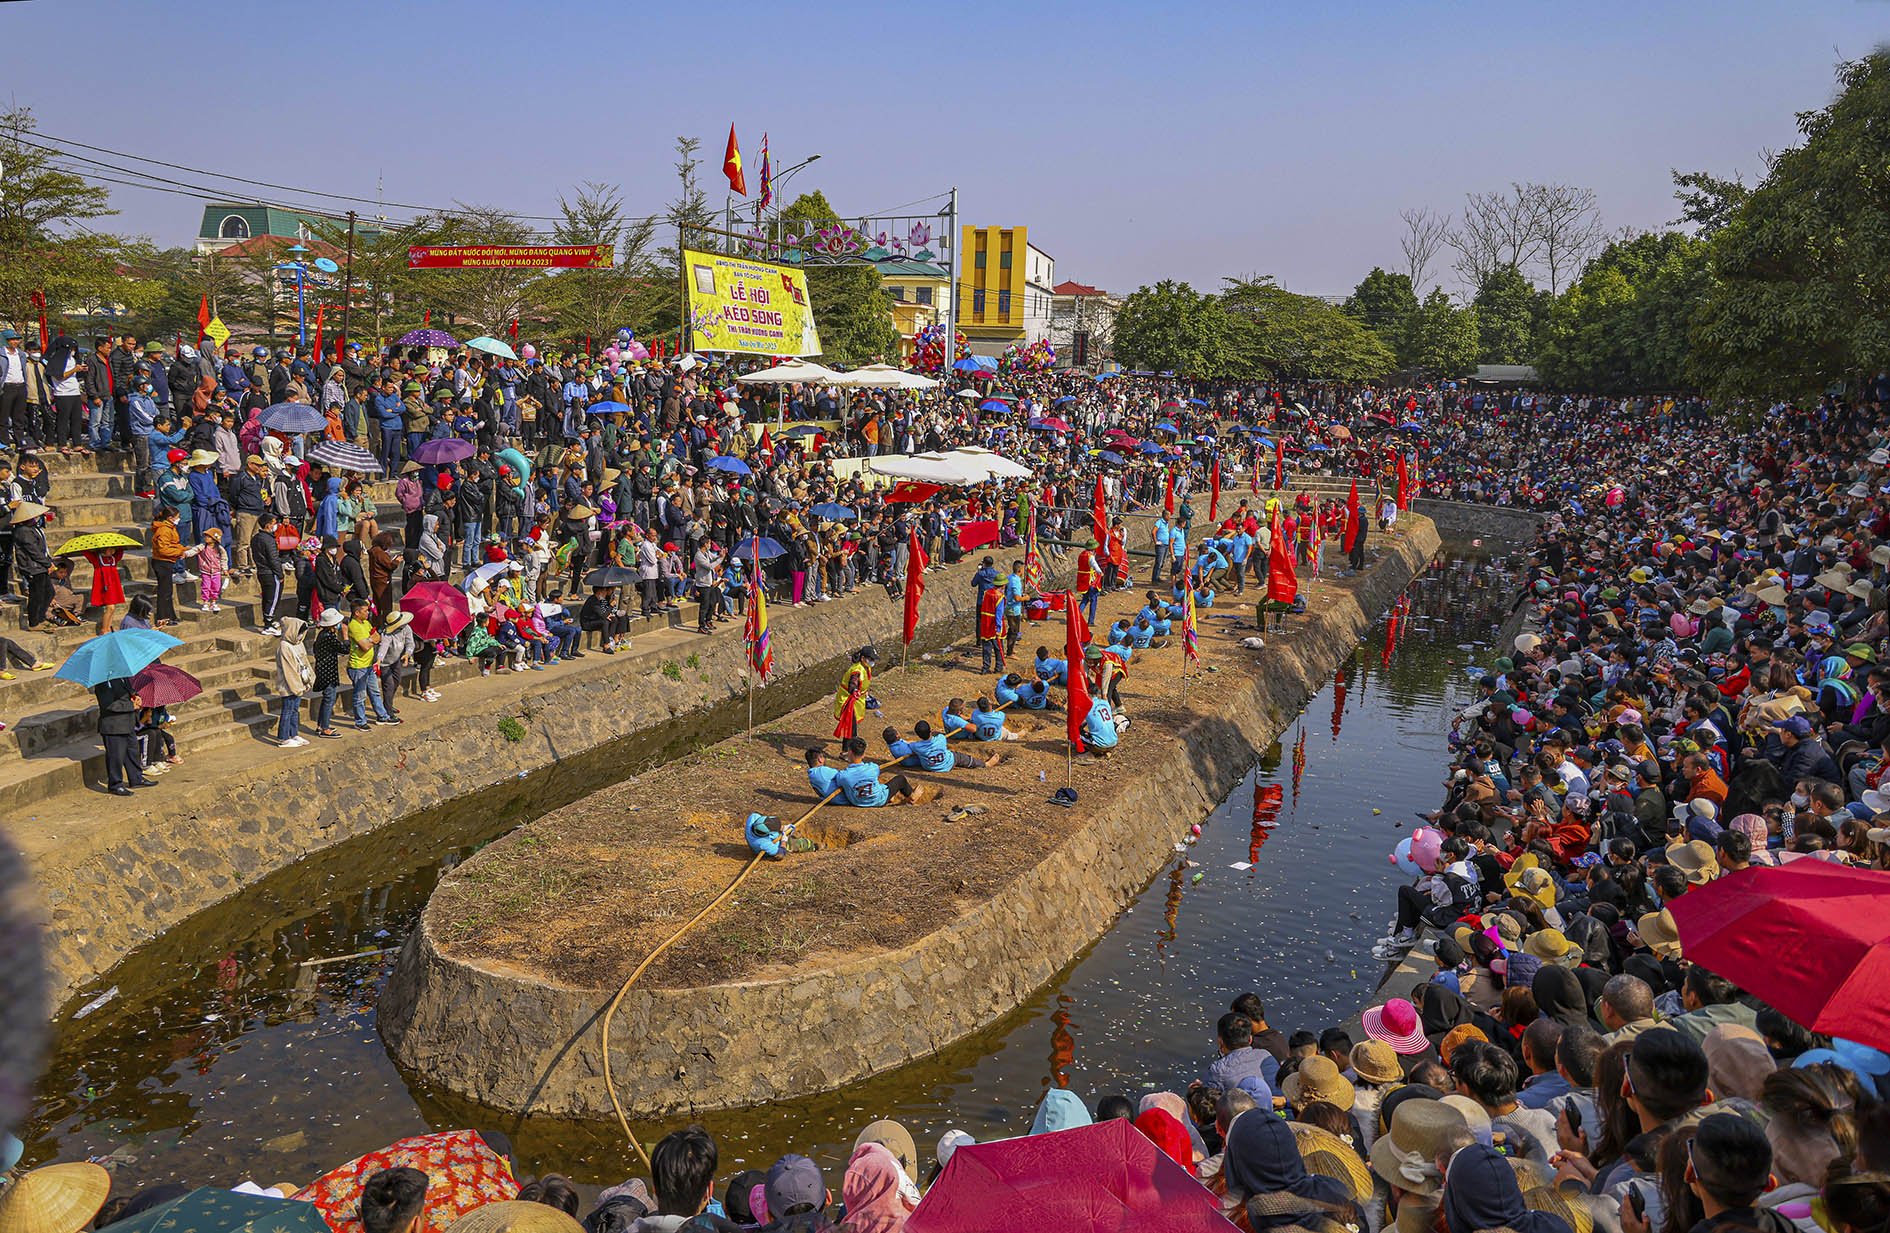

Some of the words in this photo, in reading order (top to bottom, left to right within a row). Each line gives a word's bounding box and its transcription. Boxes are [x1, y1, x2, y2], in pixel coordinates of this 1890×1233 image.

[549, 248, 573, 257] QUANG
[574, 248, 591, 256] VINH
[730, 280, 747, 301] LỄ
[749, 285, 770, 307] HỘI
[723, 303, 750, 322] KÉO
[751, 309, 783, 326] SONG
[1097, 707, 1111, 722] 13
[983, 727, 995, 737] 10
